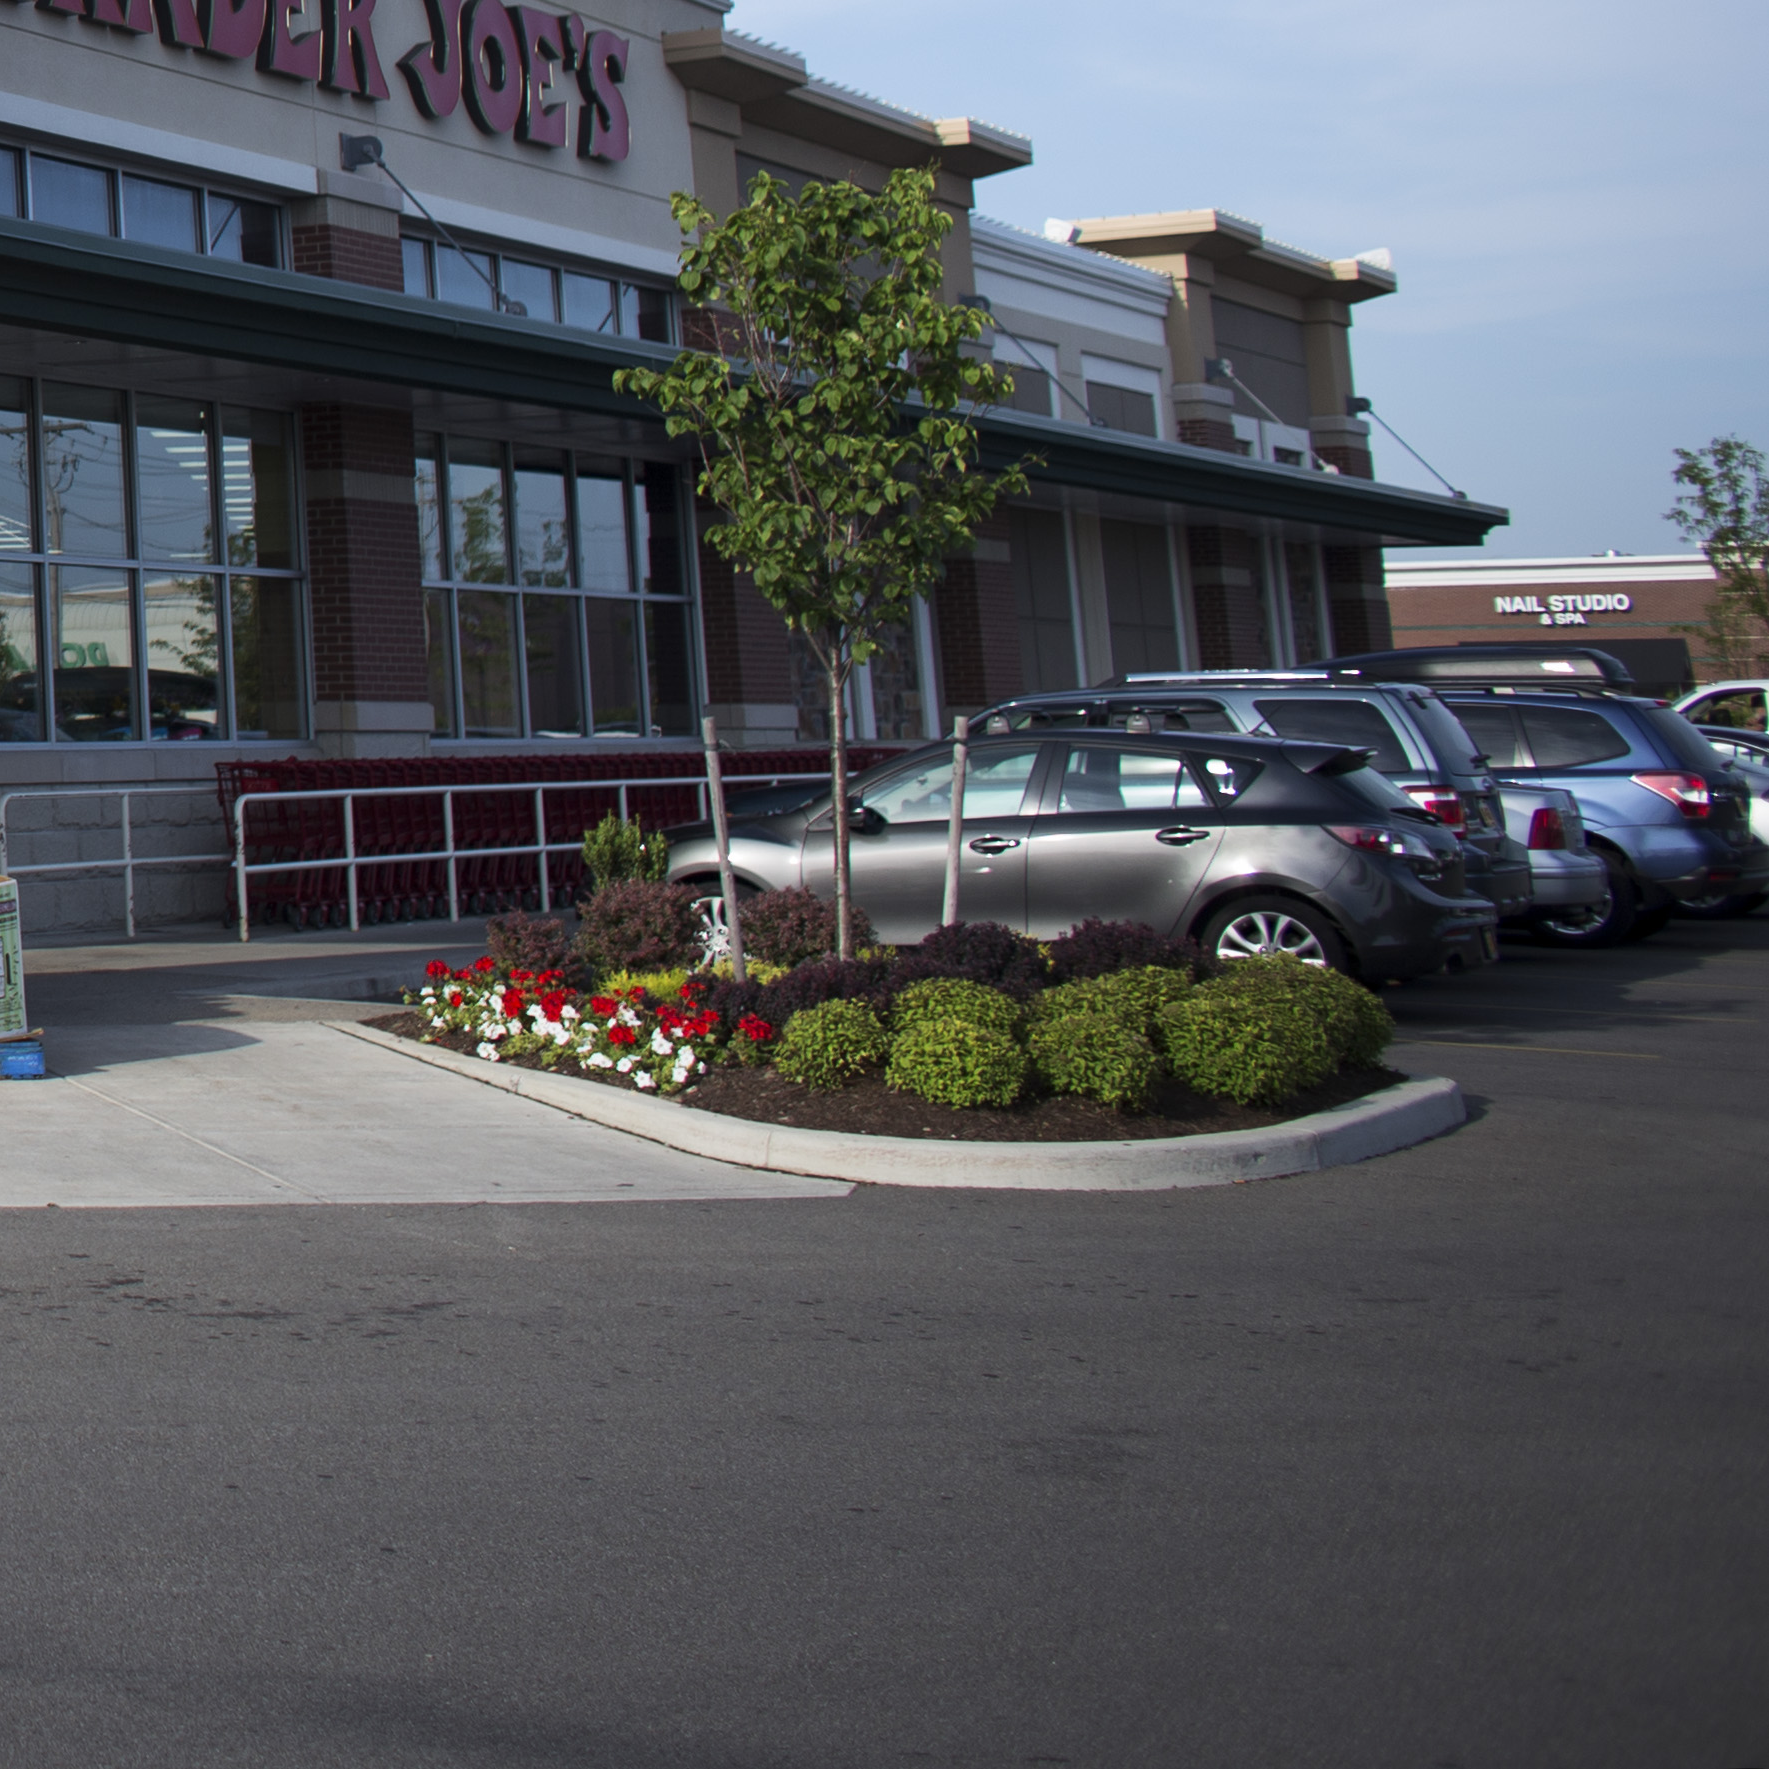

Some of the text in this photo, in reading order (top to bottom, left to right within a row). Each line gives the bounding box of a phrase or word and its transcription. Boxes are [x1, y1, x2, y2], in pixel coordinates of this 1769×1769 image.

[1494, 593, 1632, 613] NAIL STUDIO
[1539, 613, 1587, 626] & SPA
